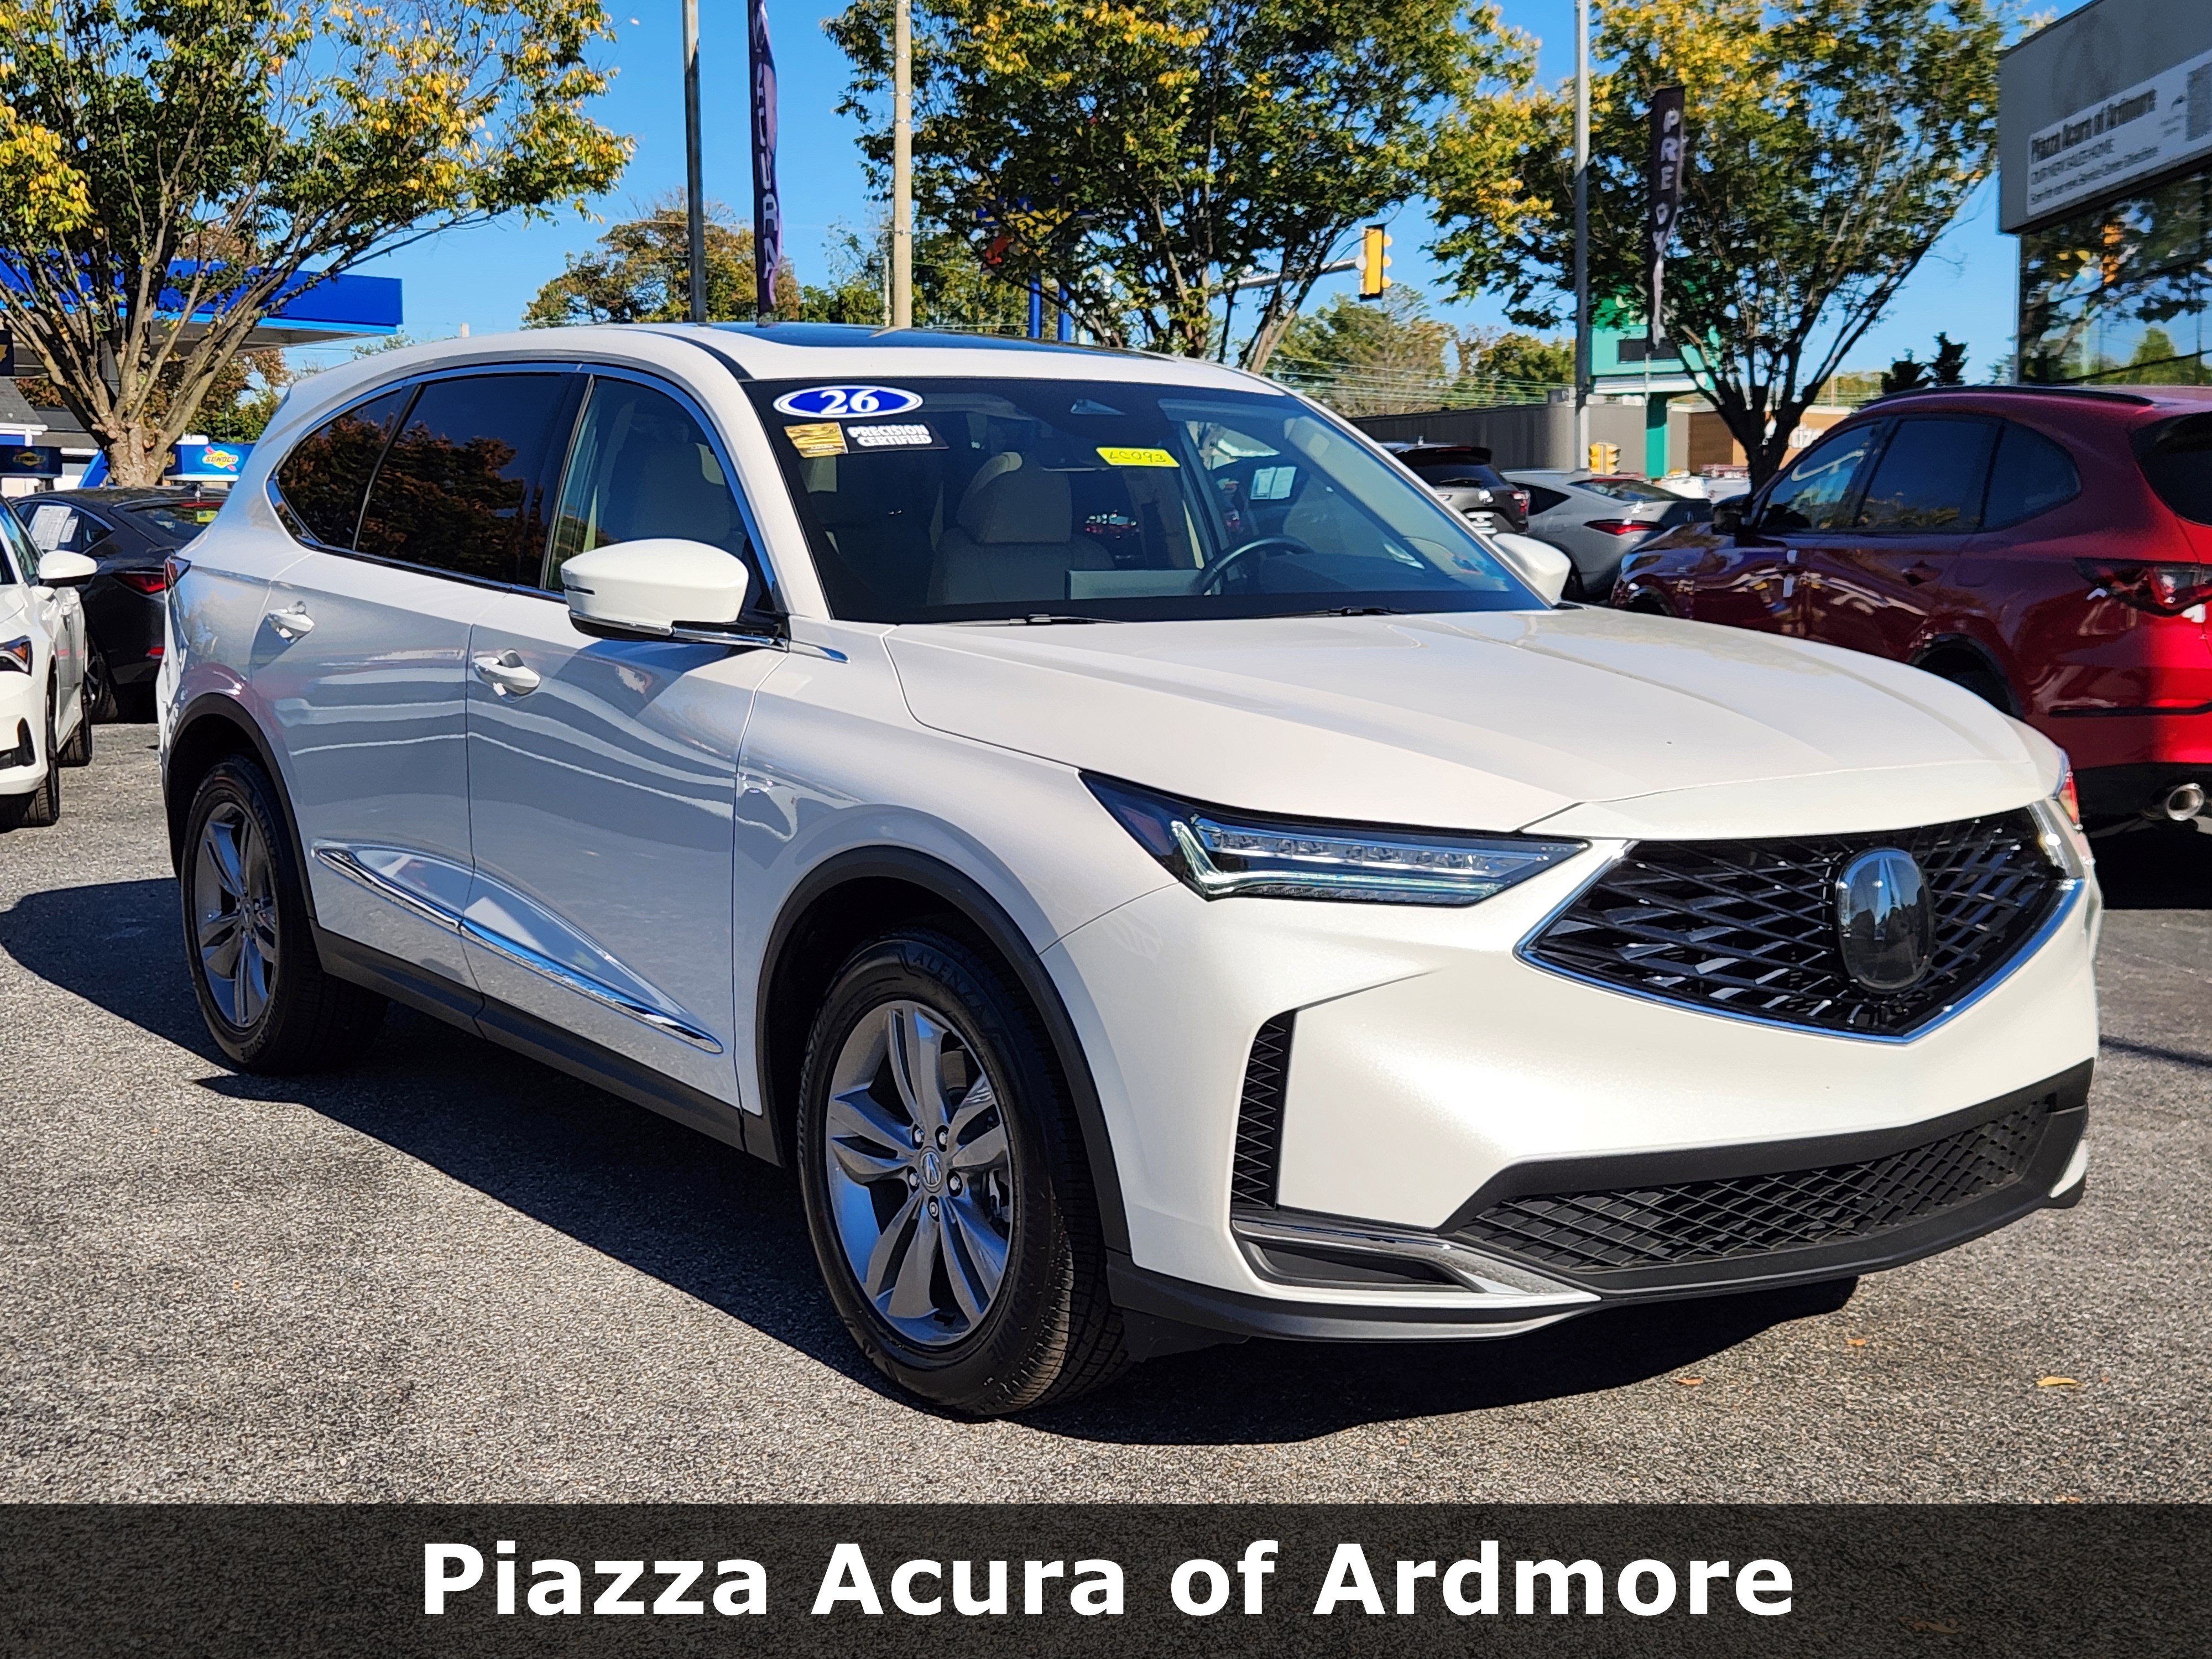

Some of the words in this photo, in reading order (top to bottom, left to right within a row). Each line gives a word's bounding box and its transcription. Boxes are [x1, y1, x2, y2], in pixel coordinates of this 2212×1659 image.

[818, 389, 880, 415] 26
[847, 424, 930, 437] PRECISION
[857, 434, 932, 447] CERTIFIED
